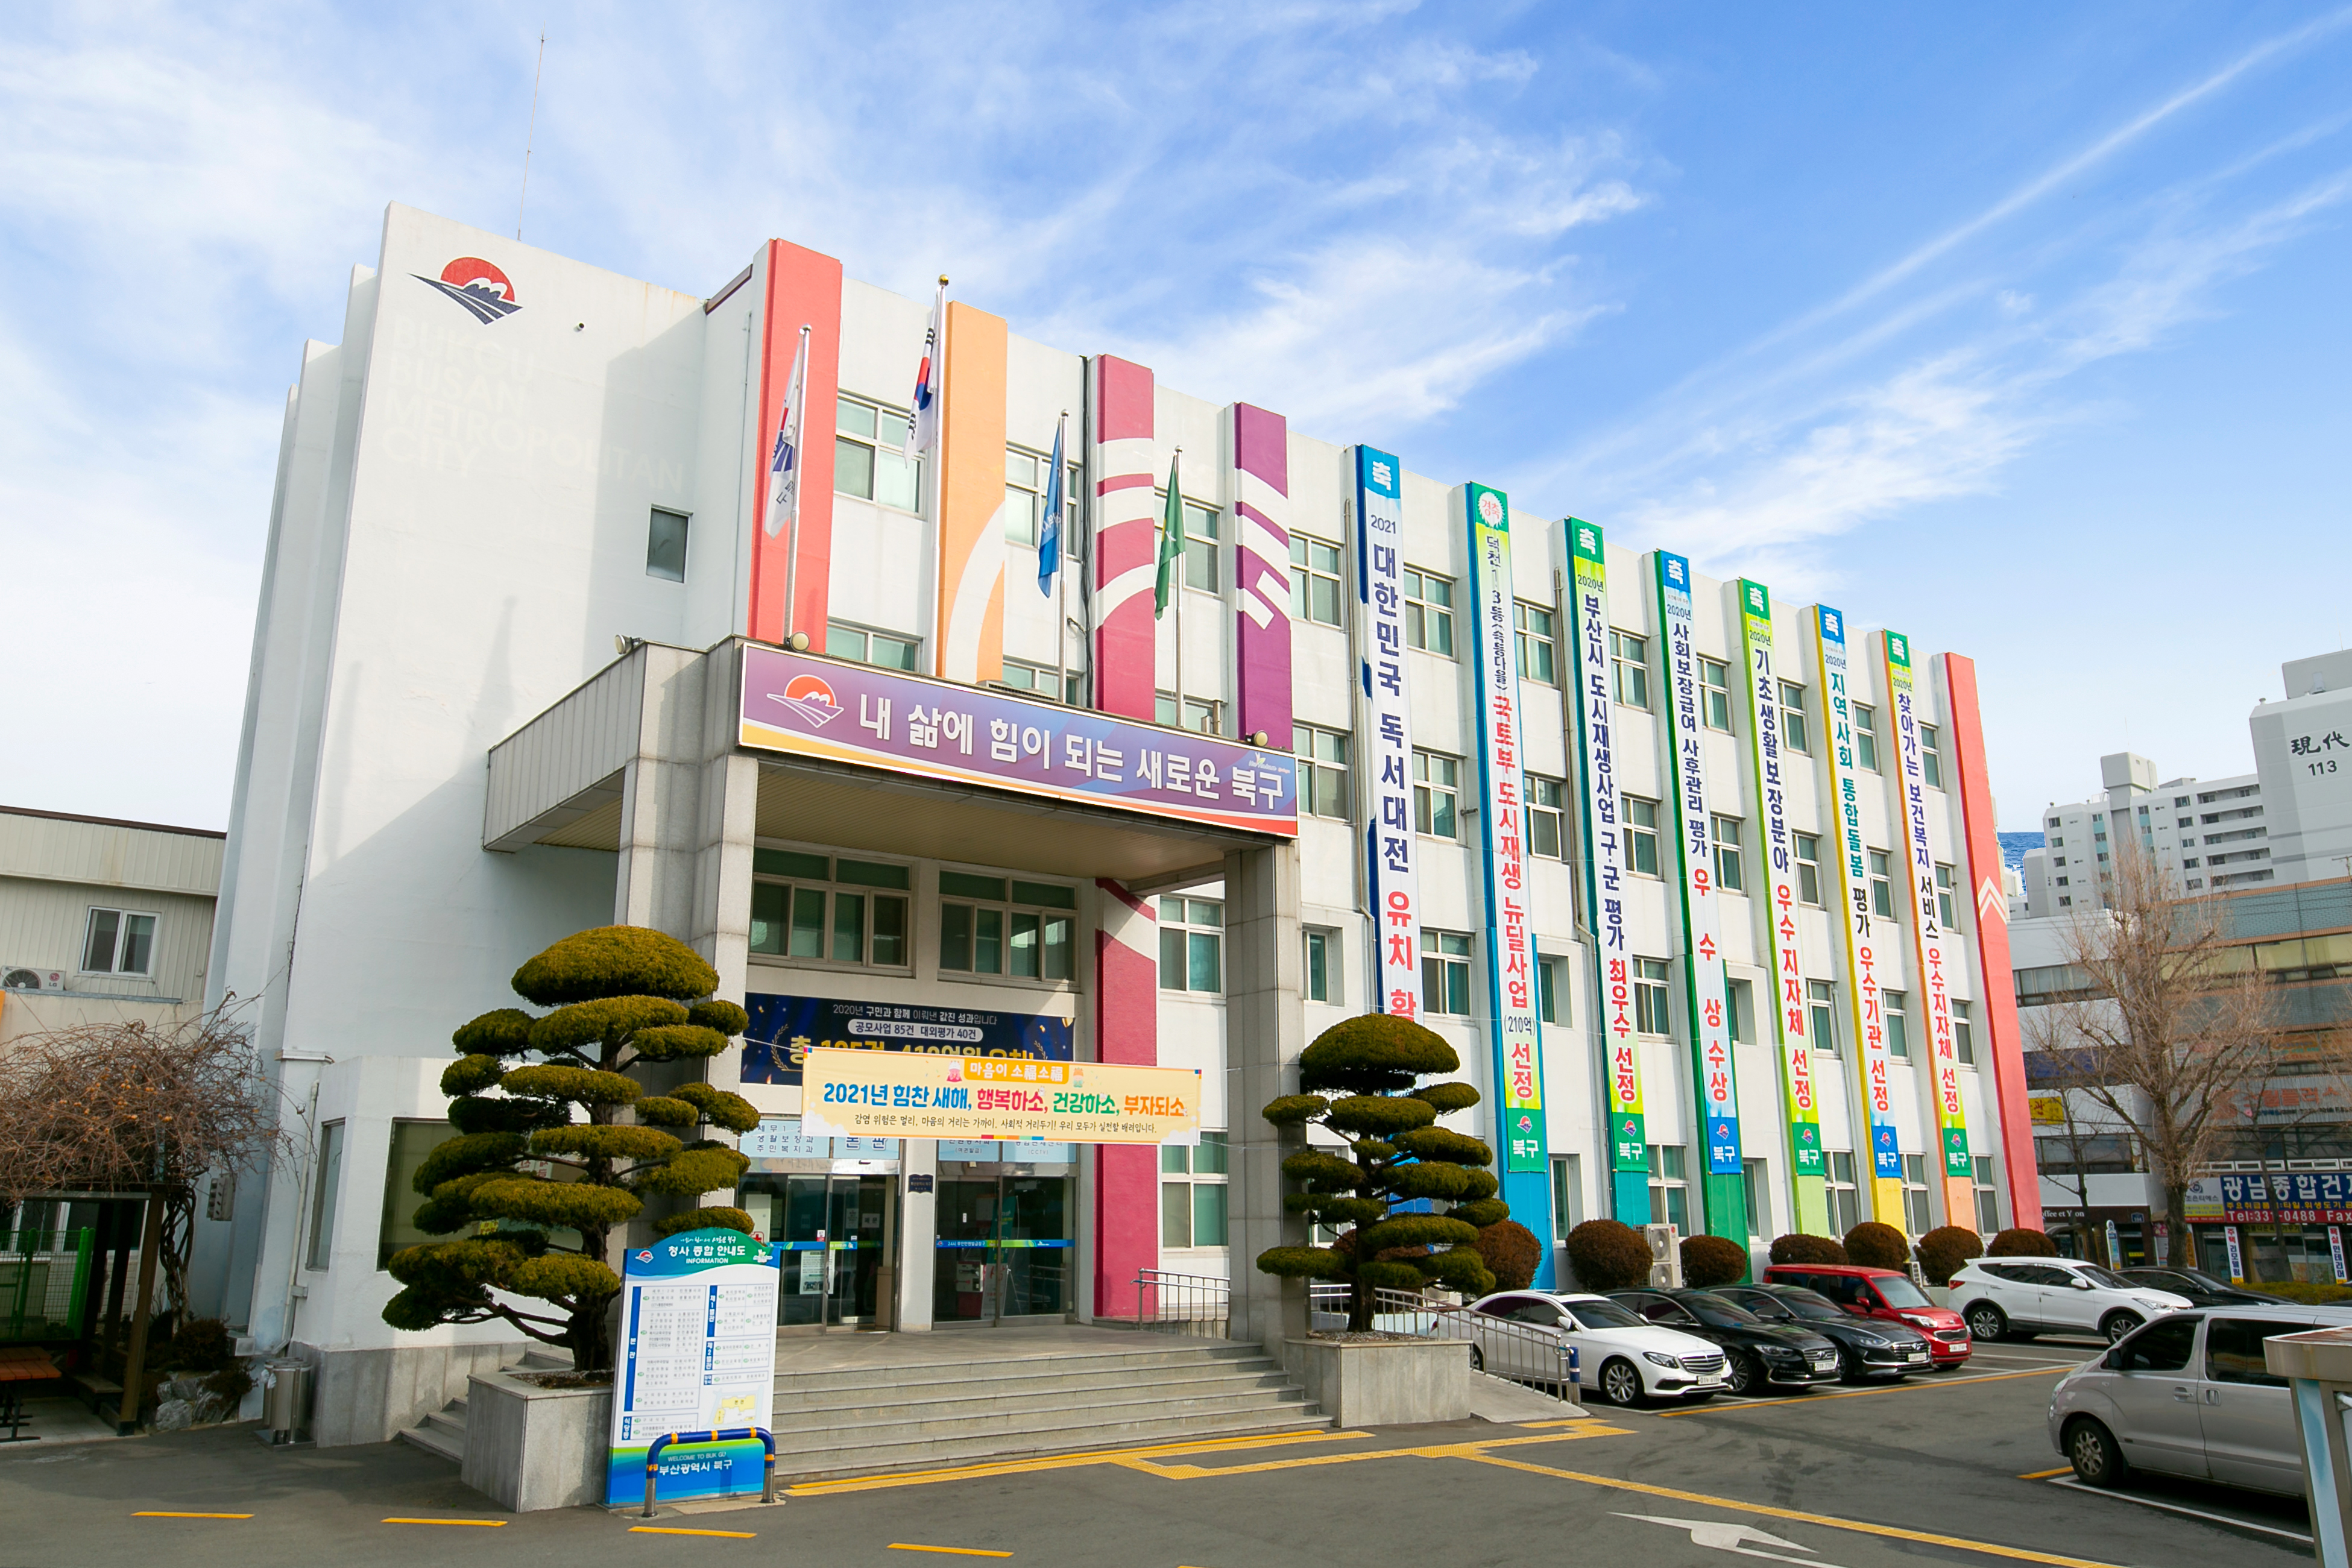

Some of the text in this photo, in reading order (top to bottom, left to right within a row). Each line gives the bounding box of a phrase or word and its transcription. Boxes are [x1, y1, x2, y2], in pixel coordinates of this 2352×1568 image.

[388, 351, 526, 418] BUSAN
[382, 426, 481, 479] CITY
[384, 386, 683, 494] METROPOLITAN
[1372, 461, 1392, 491] 축
[1370, 514, 1396, 534] 2021
[1481, 499, 1500, 519] 경축
[1579, 527, 1596, 555] 축
[1668, 559, 1683, 585] 축
[1667, 604, 1692, 621] 2020년
[1749, 587, 1764, 612] 축
[1373, 543, 1401, 697] 대한민국
[1825, 613, 1838, 637] 축
[1749, 630, 1771, 646] 2020년
[1891, 637, 1905, 660] 축
[1673, 623, 1696, 732] 사회보장급여
[1825, 654, 1846, 670] 2020년
[1893, 677, 1912, 691] 2020년
[1493, 695, 1516, 773] 국토부
[1831, 672, 1853, 770] 지역사회
[1899, 693, 1918, 776] 찾아가는
[859, 693, 1284, 810] 내 삶에 힘이 되는 새로운 북구
[2291, 731, 2350, 755] 現代
[1683, 738, 1703, 813] 사후관리
[1755, 649, 1788, 874] 기초생활보장분야
[2308, 760, 2337, 776] 113
[1379, 713, 1409, 874] 독서대전
[1498, 781, 1521, 890] 도시재생
[1577, 573, 1636, 1102] 2020년 부산시 도시재생사업 구·군 평가 최우수 선정
[1689, 819, 1707, 858] 평가
[1843, 778, 1864, 878] 통합돌봄
[1910, 783, 1929, 869] 보건복지
[1853, 887, 1870, 938] 평가
[1921, 876, 1938, 939] 서비스
[1387, 891, 1413, 971] 유치
[1504, 896, 1528, 1009] 뉴딜사업
[833, 1004, 863, 1016] 2020년
[866, 1006, 891, 1018] 구민과
[894, 1008, 910, 1019] 함께
[939, 1012, 956, 1024] 값진
[958, 1013, 997, 1025] 성과입니다
[1504, 1014, 1536, 1037] (210억)
[856, 1022, 976, 1040] 공모사업 85건 대외평가 40건
[970, 1062, 1063, 1082] 마음이 소福소福
[1511, 1043, 1533, 1099] 선정
[1792, 1049, 1811, 1109] 선정
[1871, 1060, 1888, 1111] 선정
[824, 1083, 1185, 1116] 2021년 힘찬 새해, 행복하소, 건강하소, 부자되소
[1942, 1068, 1958, 1112] 선정
[855, 1113, 1157, 1133] 감염 위험은 멀리, 마음의 거리는 가까이. 사회적 거리두기! 우리 모두가 실천할 배려입니다.
[1512, 1139, 1539, 1158] 북구
[1619, 1142, 1643, 1161] 북구
[1714, 1145, 1736, 1163] 북구
[1799, 1149, 1820, 1165] 북구
[1878, 1152, 1897, 1168] 북구
[1949, 1152, 1967, 1167] 북구
[2224, 1175, 2352, 1201] 광남종합건
[669, 1245, 746, 1257] 청사 종합 안내도
[2227, 1228, 2240, 1276] 주택 리모델링
[2333, 1245, 2345, 1277] 인테리어
[659, 1459, 732, 1475] 부산광역시 북구
